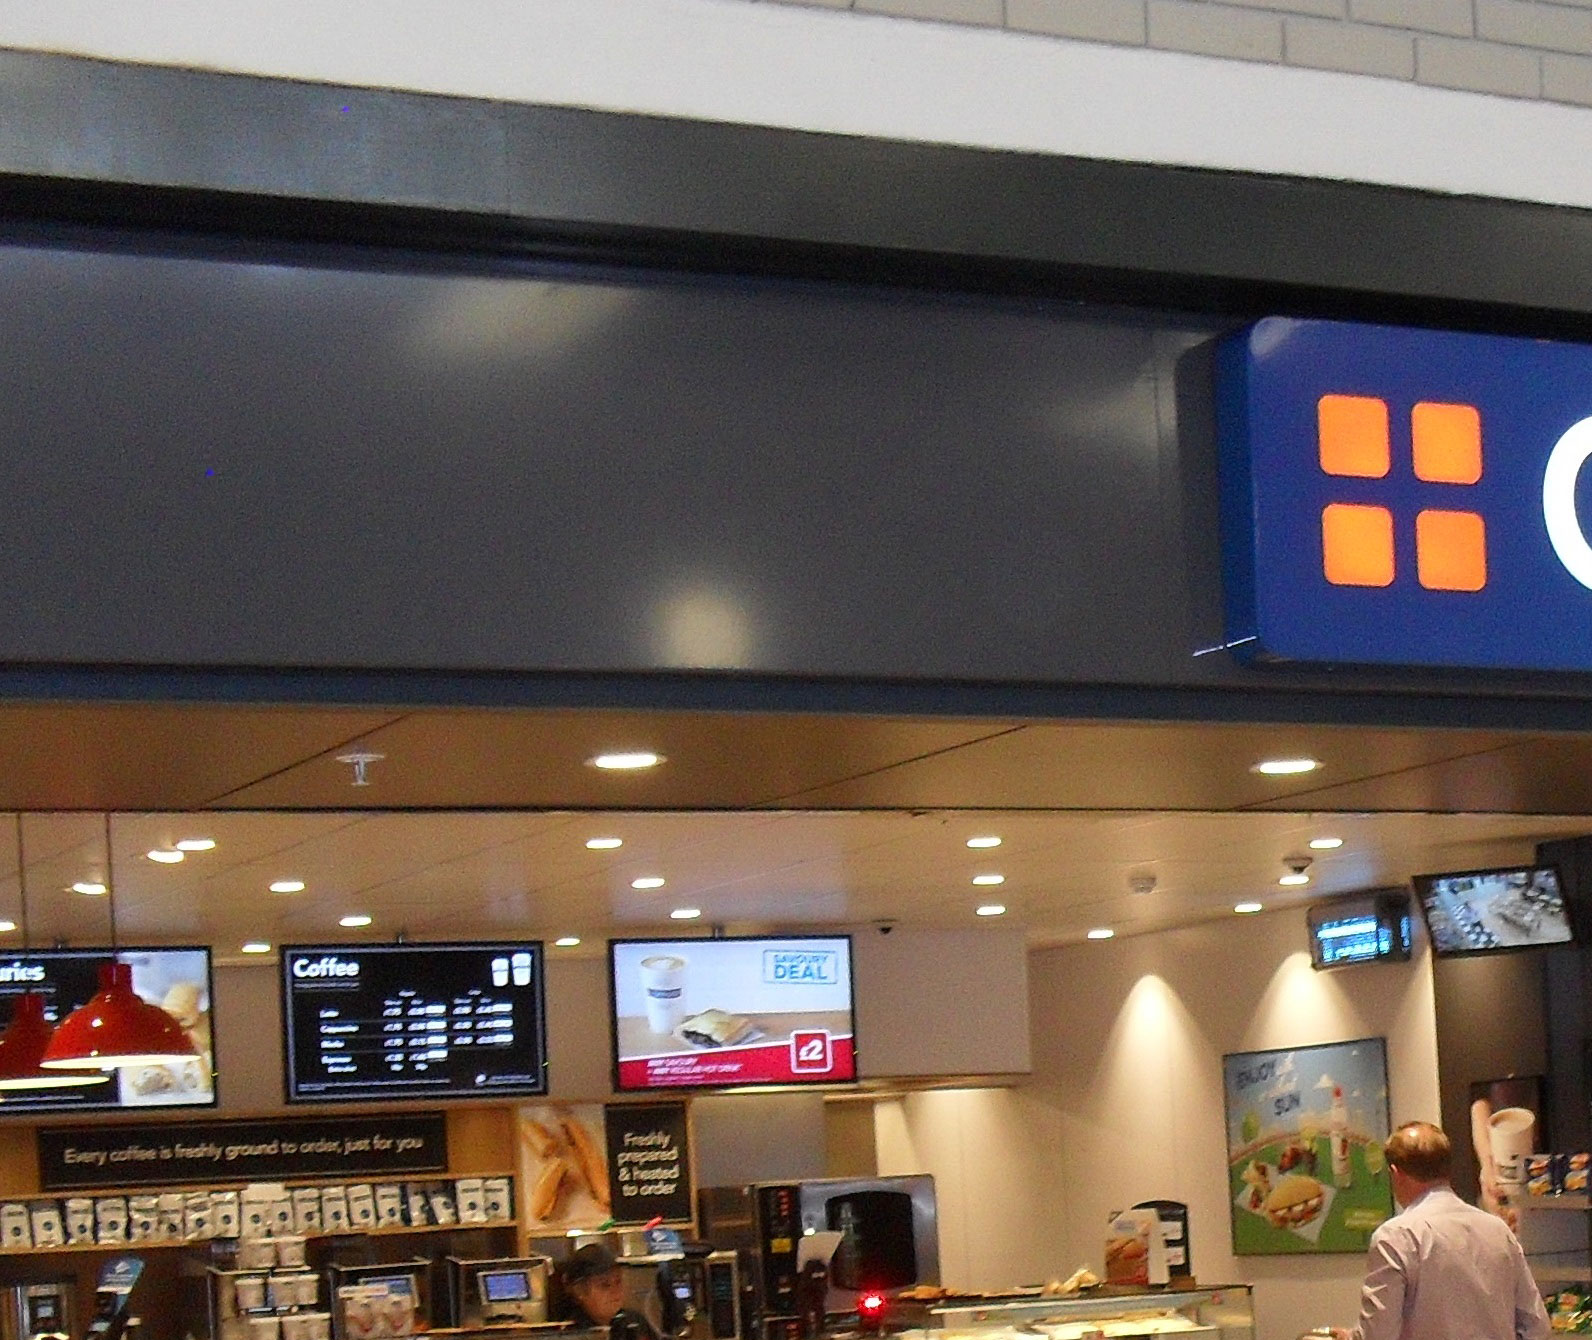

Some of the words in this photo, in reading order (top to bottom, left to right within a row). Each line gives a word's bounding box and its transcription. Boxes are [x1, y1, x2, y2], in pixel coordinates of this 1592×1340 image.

[292, 957, 360, 978] Coffee
[774, 964, 828, 980] DEAL
[624, 1130, 671, 1149] Freshly
[64, 1147, 107, 1167] Every
[109, 1145, 157, 1162] coffee
[158, 1145, 173, 1160] is
[174, 1142, 223, 1162] freshly
[224, 1138, 279, 1161] ground
[280, 1140, 298, 1154] to
[343, 1137, 371, 1156] just
[372, 1134, 395, 1150] for
[395, 1137, 424, 1153] you
[617, 1146, 679, 1167] prepared
[618, 1166, 632, 1181] &
[632, 1164, 680, 1181] heated
[622, 1183, 639, 1197] to
[640, 1180, 677, 1196] order
